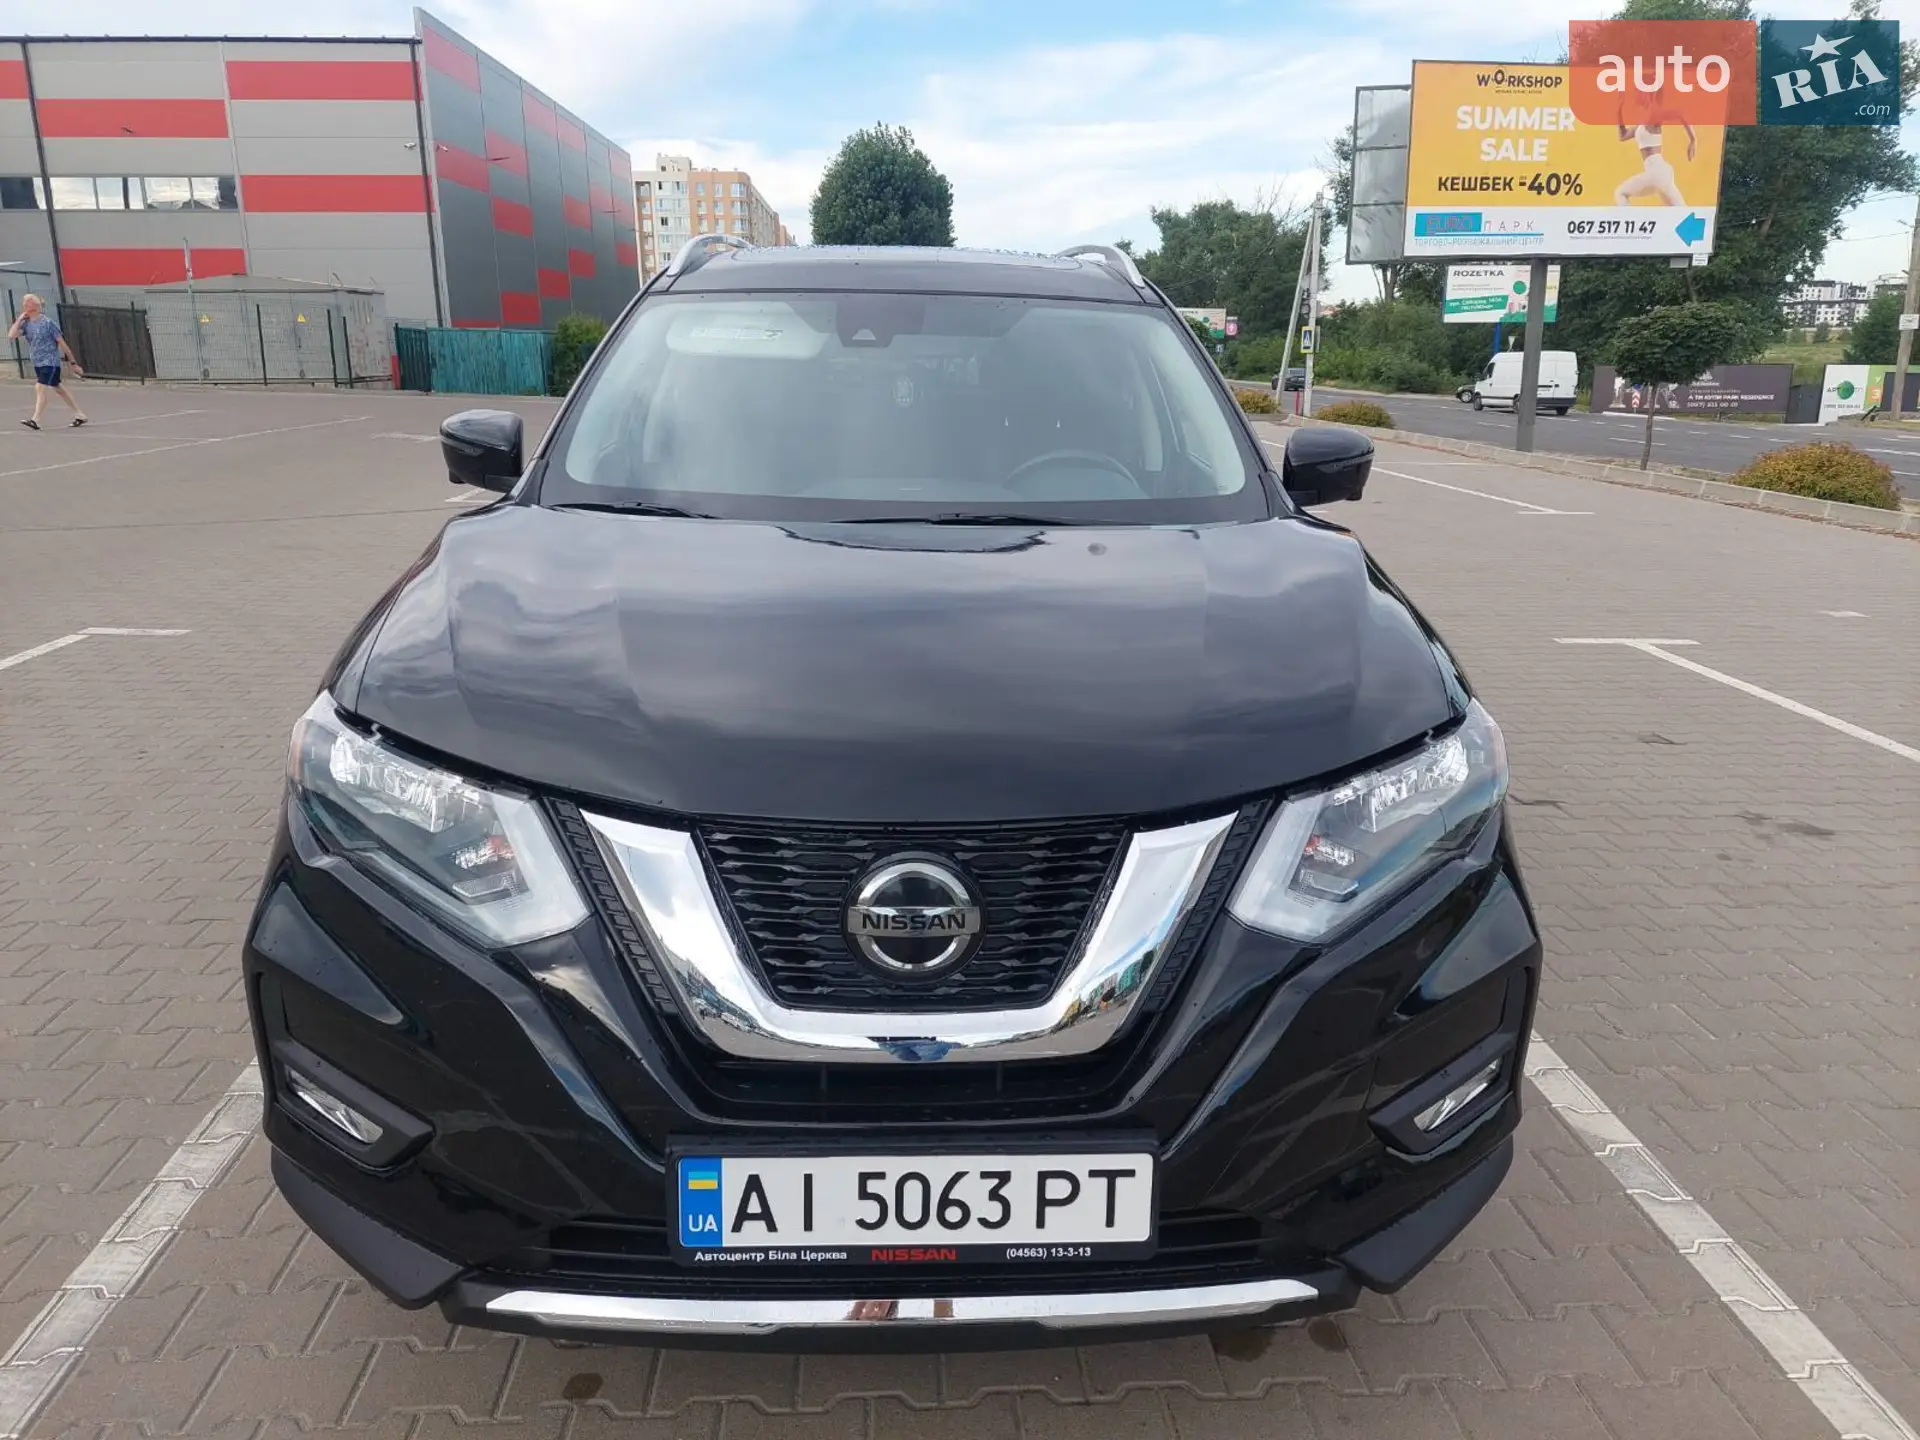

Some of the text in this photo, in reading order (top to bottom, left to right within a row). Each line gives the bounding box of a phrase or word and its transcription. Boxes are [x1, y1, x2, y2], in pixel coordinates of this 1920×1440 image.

[1476, 69, 1563, 89] WORKSHOP
[1456, 105, 1576, 131] SUMMER
[1480, 137, 1549, 162] SALE
[1438, 176, 1514, 192] КЕШБЕК
[1484, 220, 1536, 232] ПАРК
[1567, 220, 1657, 234] 067 517 11 47
[1453, 269, 1505, 277] ROZETKA
[862, 913, 966, 930] NISSAN
[731, 1169, 1136, 1233] AI 5063 PT
[688, 1214, 719, 1232] UA
[694, 1249, 848, 1262] Автоцентр Біла Церква
[871, 1248, 957, 1261] NISSAN
[1006, 1247, 1092, 1260] (04563) 13-3-13
